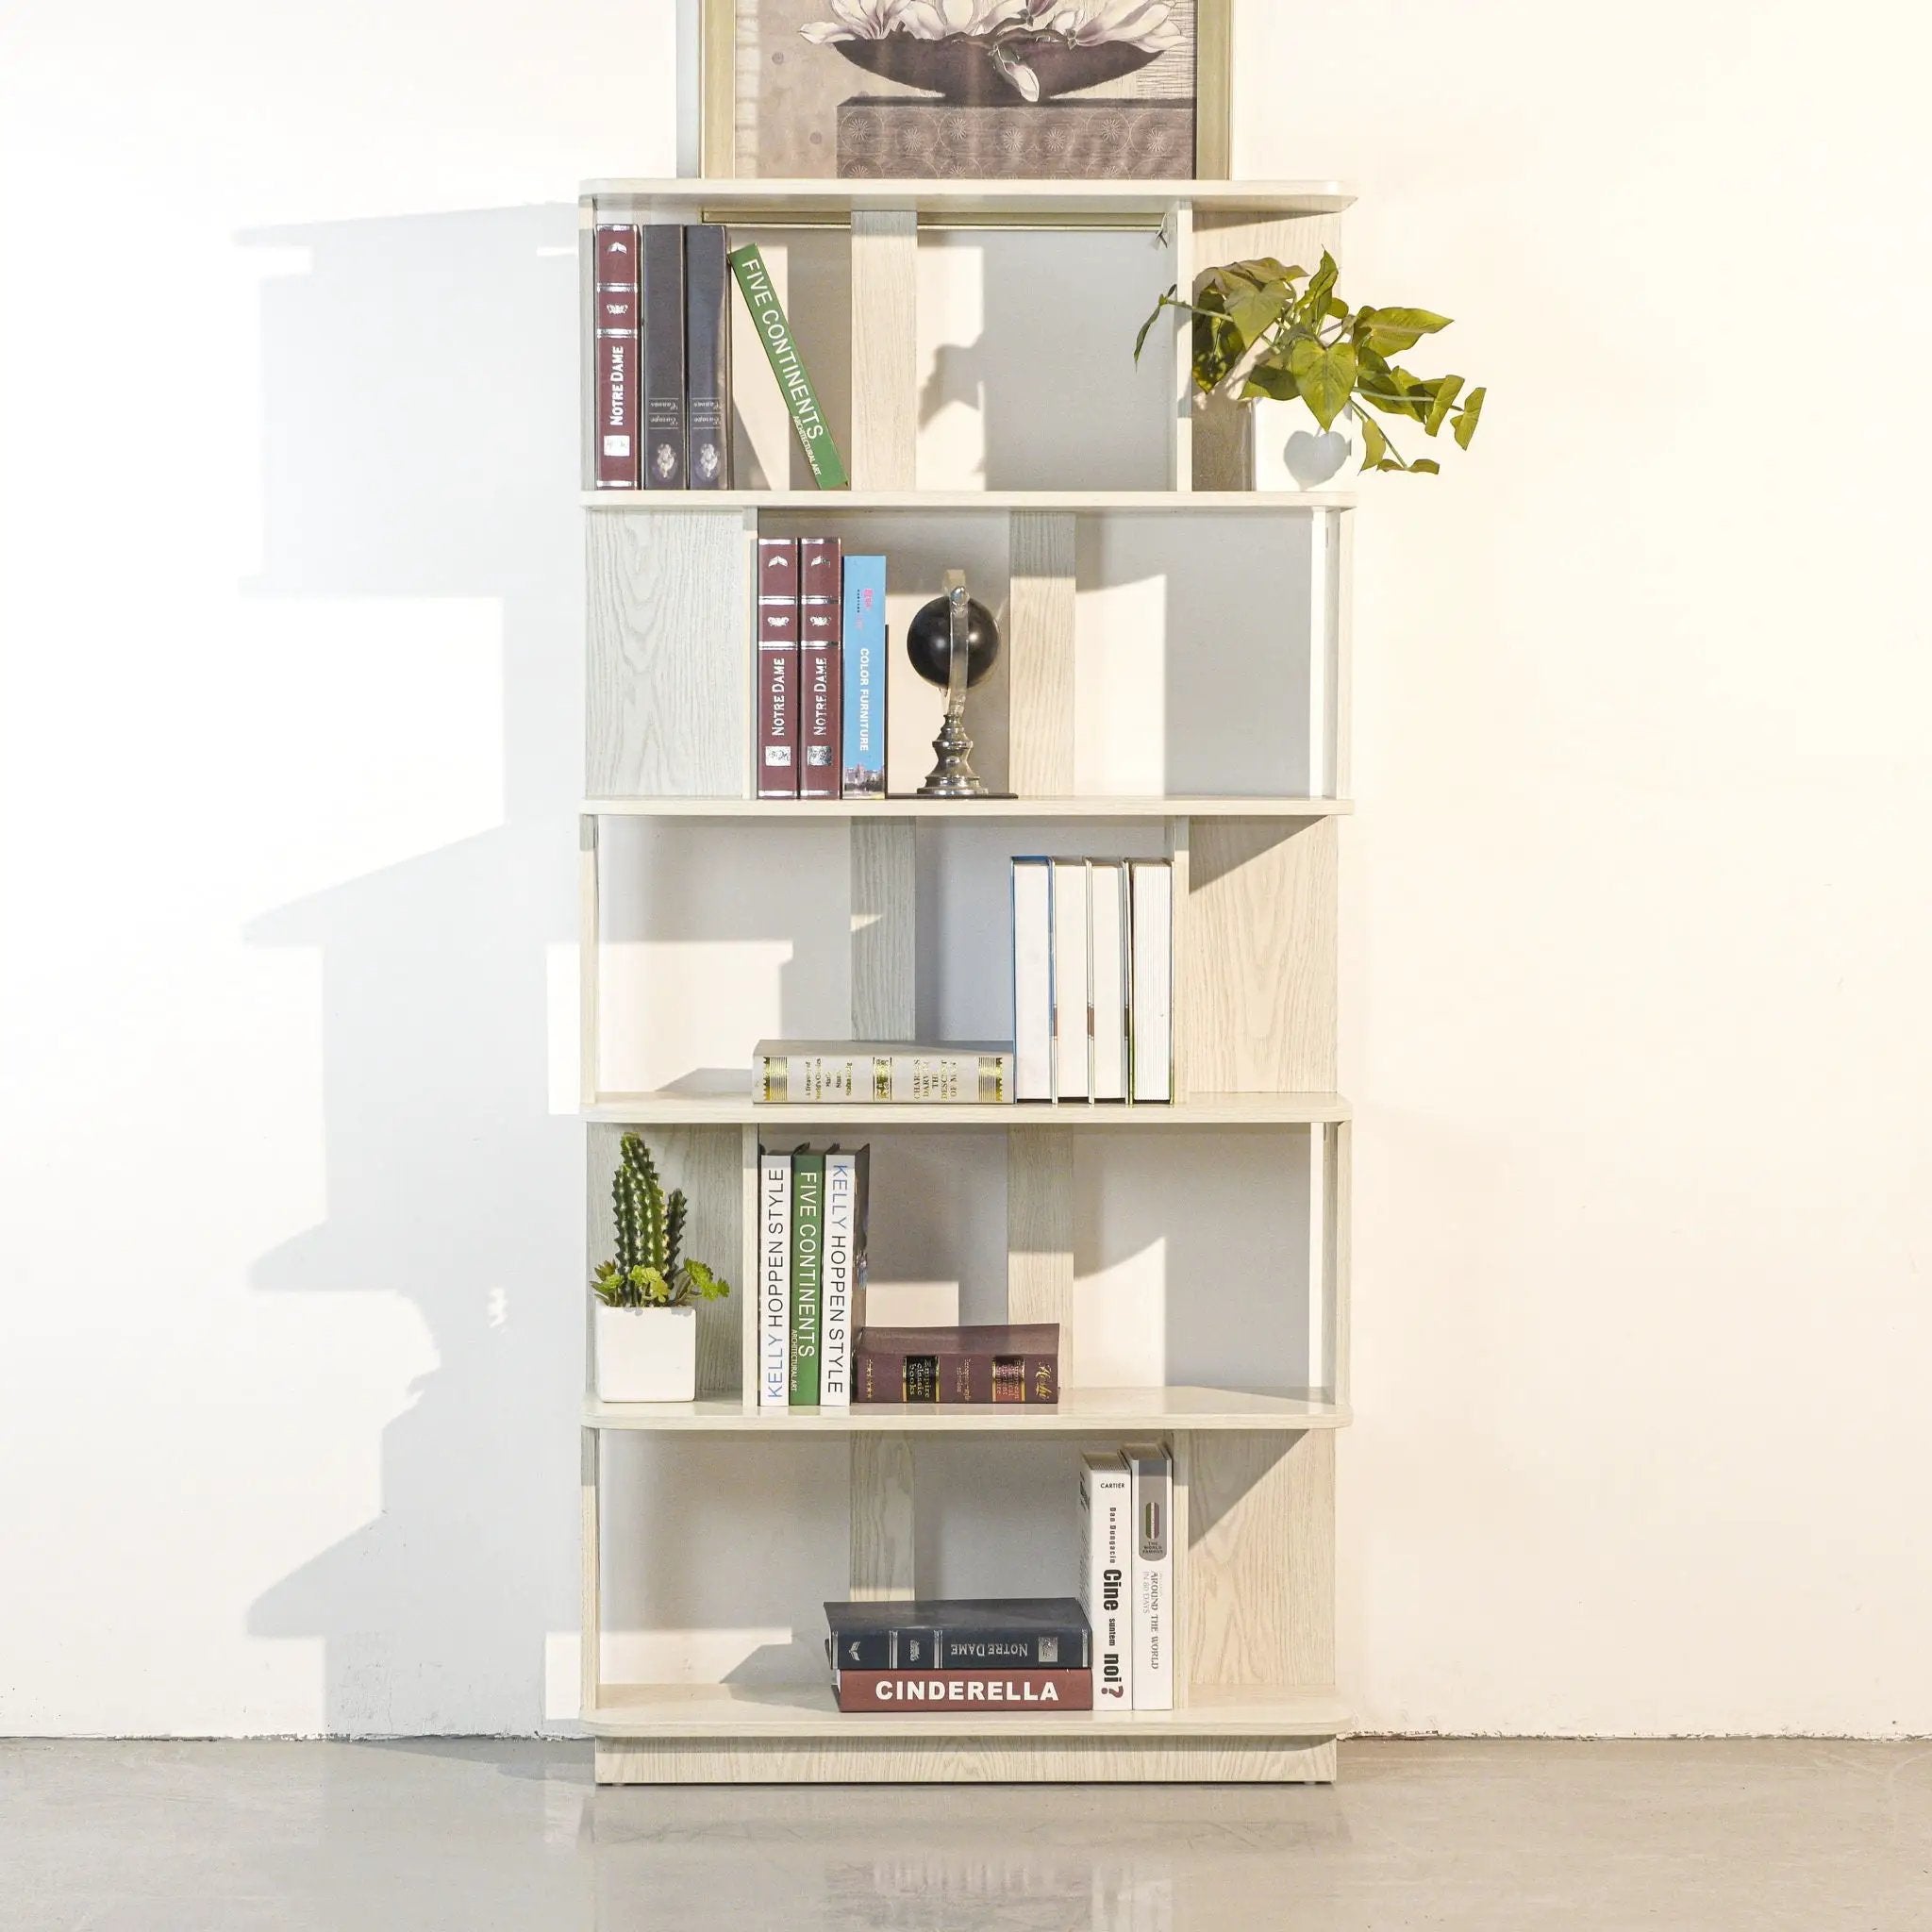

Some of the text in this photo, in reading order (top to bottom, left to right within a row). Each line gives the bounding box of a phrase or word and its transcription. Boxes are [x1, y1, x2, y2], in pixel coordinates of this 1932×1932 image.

[610, 345, 625, 426] NOTRE DAME
[742, 258, 824, 440] FIVE CONTINENTS
[793, 415, 816, 463] ARCHITECTURAL
[772, 658, 785, 736] NOTRE DAME
[813, 658, 826, 736] NOTRE DAME
[859, 647, 870, 751] COLOR FURNITURE
[768, 1169, 784, 1398] KELLY HOPPEN STYLE
[798, 1173, 817, 1357] FIVE CONTINENTS
[827, 1165, 848, 1393] KELLY HOPPEN STYLE
[1103, 1569, 1123, 1611] Cine
[1150, 1571, 1158, 1611] AROUND
[950, 1643, 1027, 1657] NOTRE DAME
[1101, 1654, 1124, 1699] noi?
[1151, 1636, 1159, 1670] WORLD
[875, 1681, 1058, 1701] CINDERELLA
